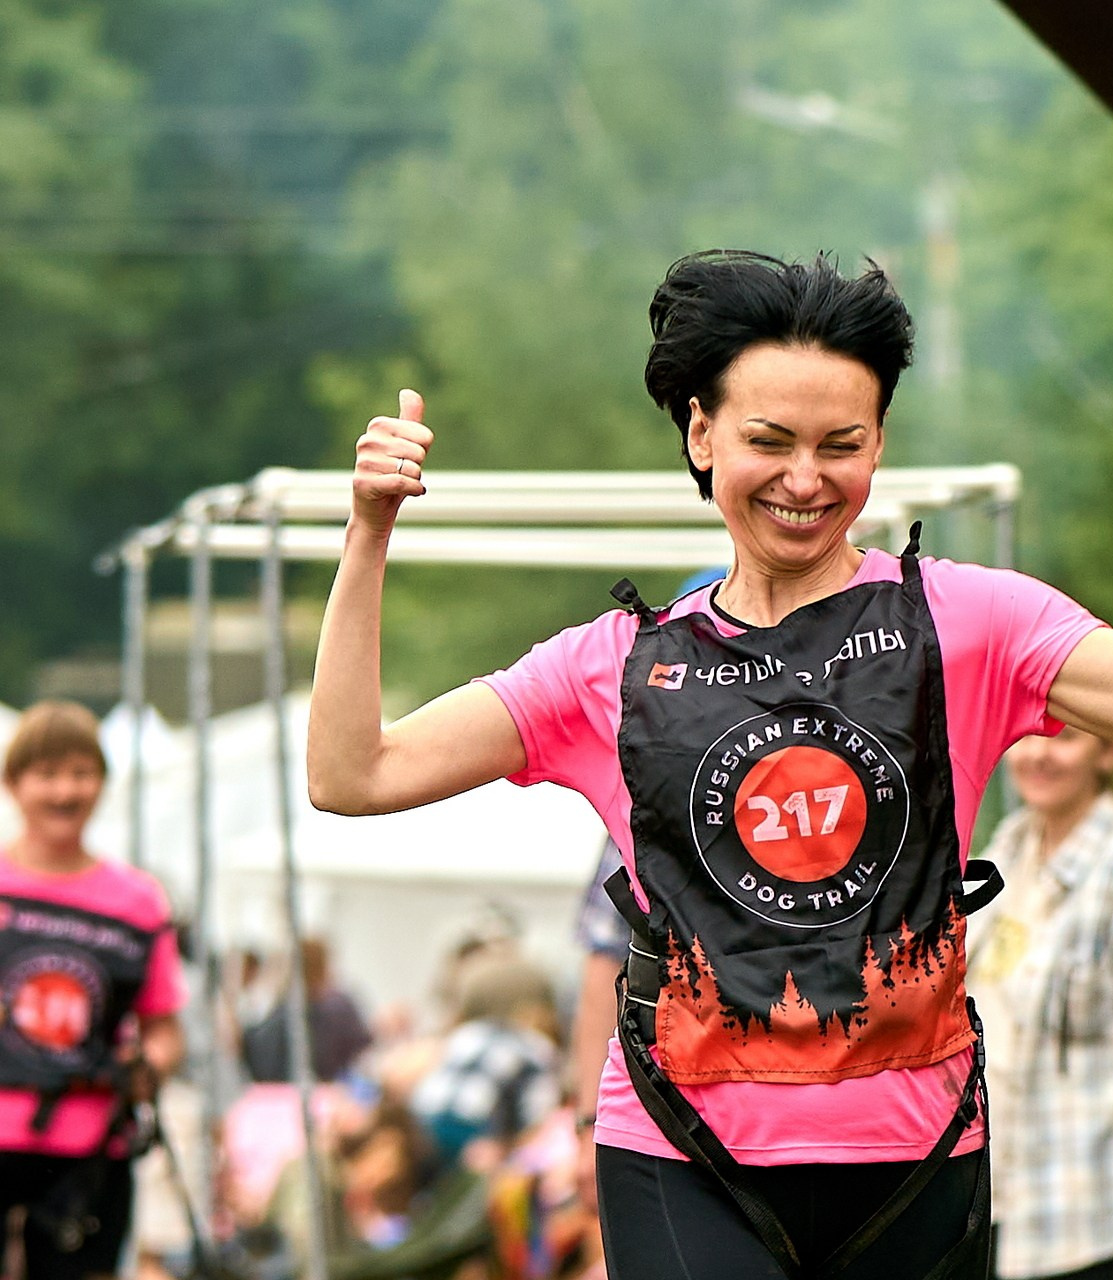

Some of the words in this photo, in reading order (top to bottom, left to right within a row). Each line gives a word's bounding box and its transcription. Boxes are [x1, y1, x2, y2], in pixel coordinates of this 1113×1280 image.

[705, 723, 783, 826] RUSSIAN
[792, 717, 894, 803] EXTREME
[747, 784, 850, 842] 217
[738, 872, 796, 910] DOG
[807, 861, 877, 910] TRAIL
